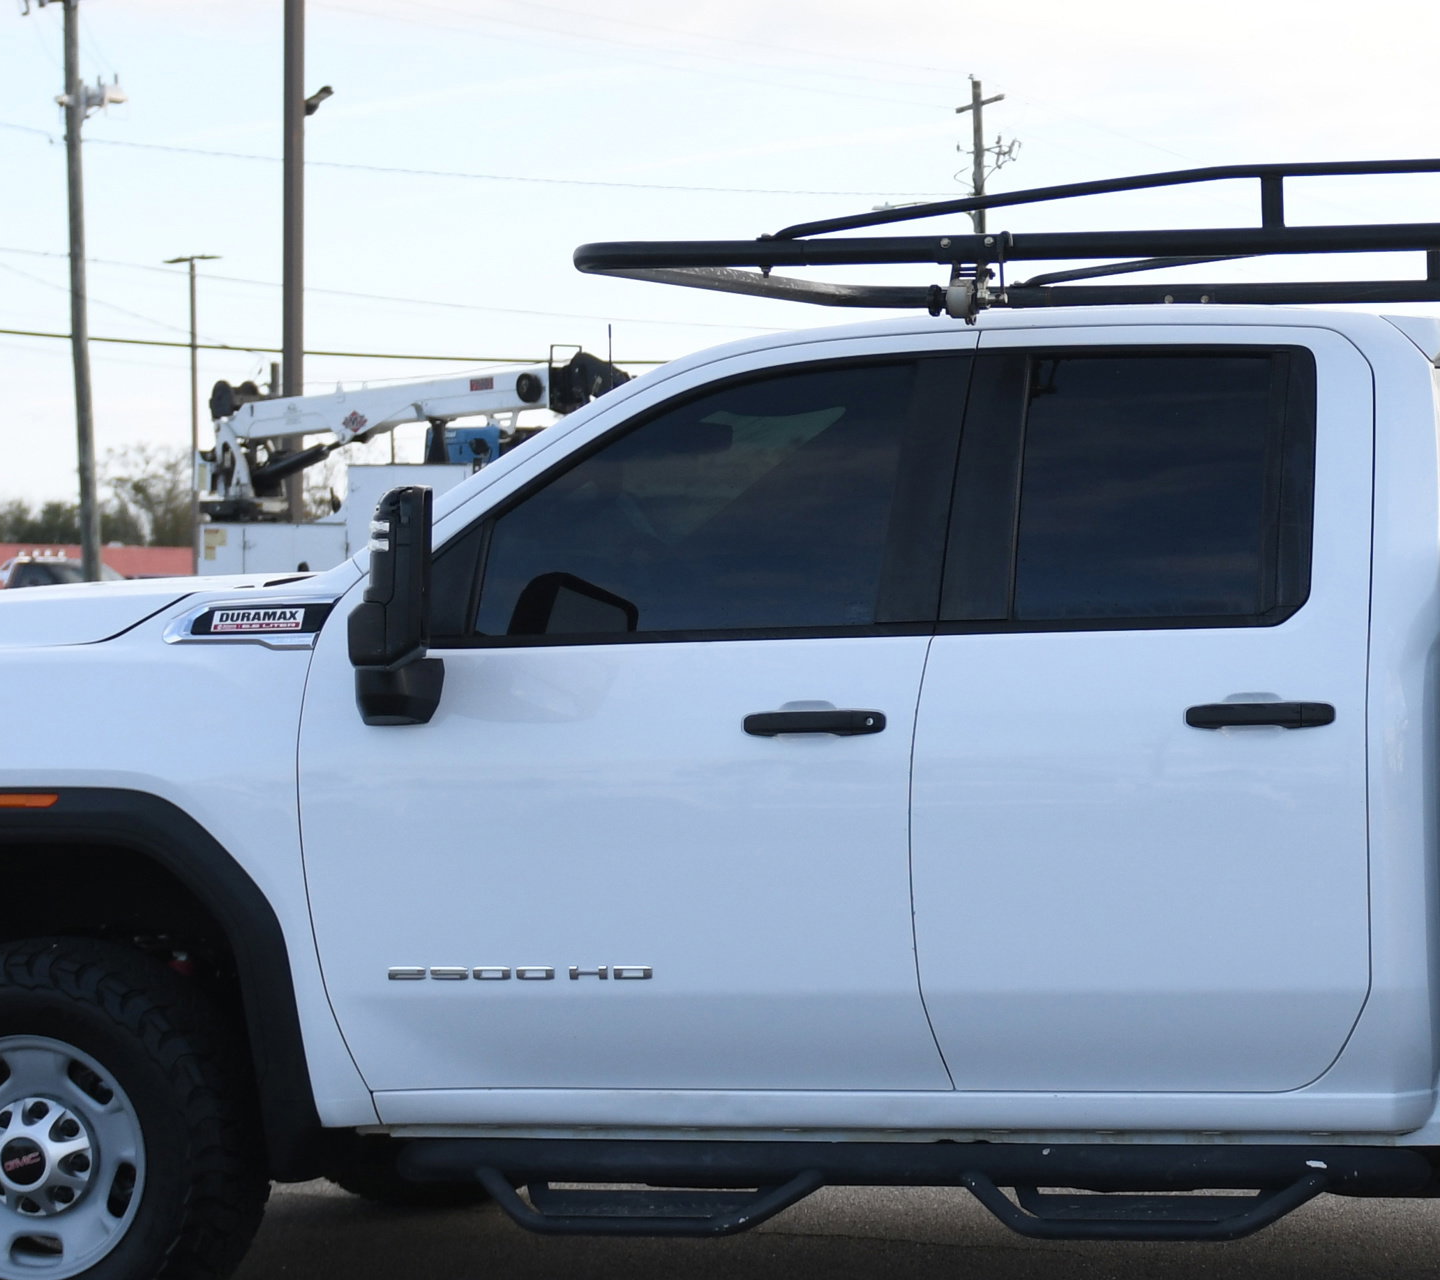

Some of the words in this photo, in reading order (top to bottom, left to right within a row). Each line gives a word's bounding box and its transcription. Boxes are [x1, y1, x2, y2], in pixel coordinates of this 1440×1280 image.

[218, 610, 299, 622] DURAMAX
[388, 966, 555, 980] 2500
[569, 965, 653, 980] HD
[4, 1151, 41, 1171] GMC
